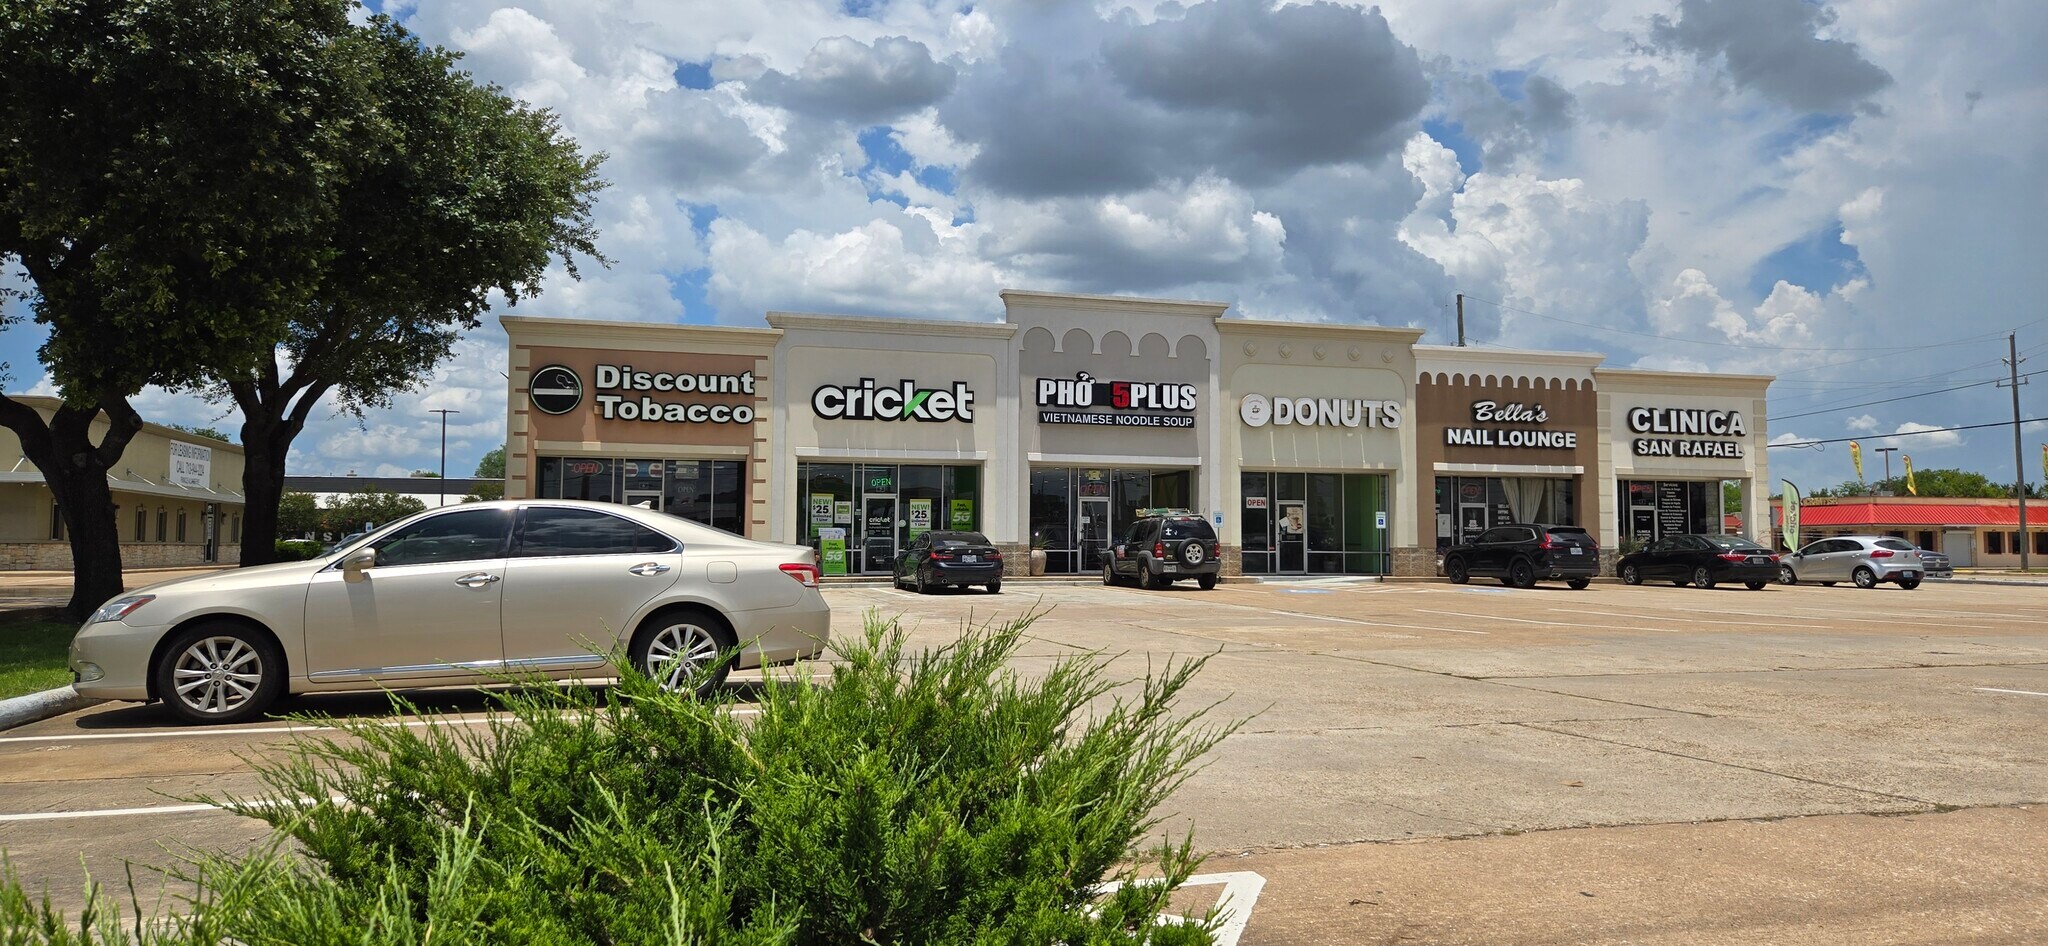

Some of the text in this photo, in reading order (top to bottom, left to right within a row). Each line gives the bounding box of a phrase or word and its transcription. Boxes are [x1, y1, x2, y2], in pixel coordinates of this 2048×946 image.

[596, 364, 755, 394] Discount
[1038, 372, 1096, 407] PHỞ
[814, 379, 973, 421] cricket
[596, 395, 755, 424] Tobacco
[1273, 397, 1402, 429] DONUTS
[1473, 401, 1549, 423] Bella's
[1042, 412, 1193, 427] VIETNAMESE NOODLE SOUP
[1631, 408, 1747, 435] CLINICA
[1447, 428, 1577, 448] NAIL LOUNGE
[1637, 440, 1744, 457] SAN RAFAEL
[573, 463, 599, 473] OPEN
[871, 478, 892, 487] OPEN
[813, 505, 829, 514] $25
[1247, 498, 1266, 507] OPEN
[911, 510, 927, 519] $25
[953, 512, 971, 521] 5G
[825, 551, 843, 561] 5G
